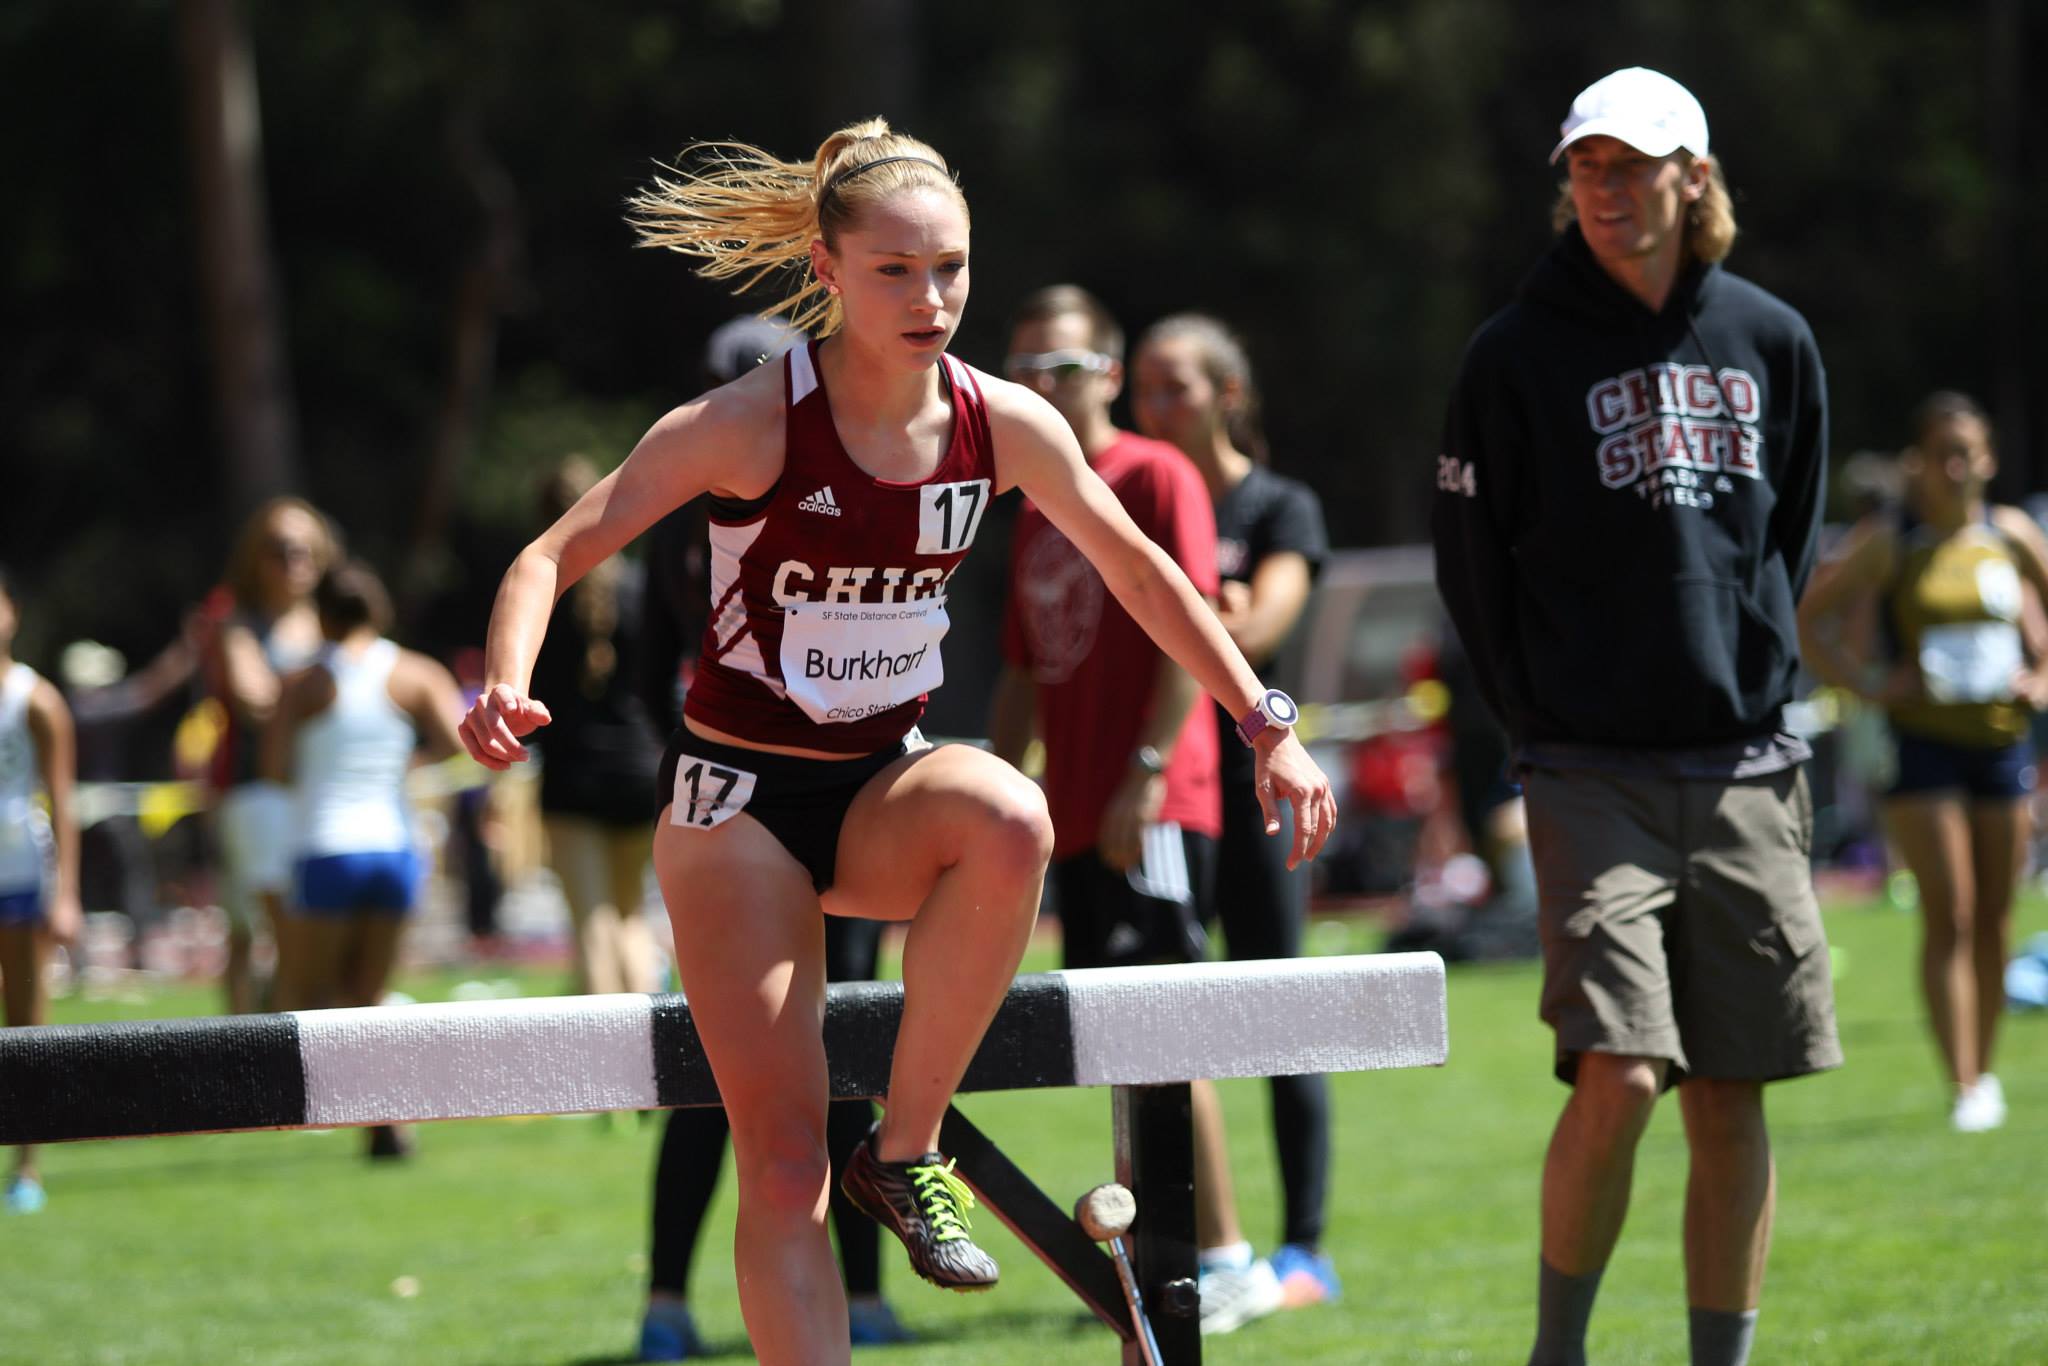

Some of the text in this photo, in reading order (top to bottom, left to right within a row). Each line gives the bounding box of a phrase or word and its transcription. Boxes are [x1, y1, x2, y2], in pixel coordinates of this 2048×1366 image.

[1585, 362, 1760, 434] CHICO
[1597, 414, 1763, 489] STATE
[798, 500, 842, 517] adidas
[934, 484, 981, 550] 17
[772, 560, 948, 606] CHIC
[822, 611, 833, 620] SF
[834, 611, 858, 620] State
[860, 611, 897, 621] Distance
[805, 643, 928, 681] Burkhart
[827, 706, 864, 720] Chico
[684, 763, 740, 827] 17
